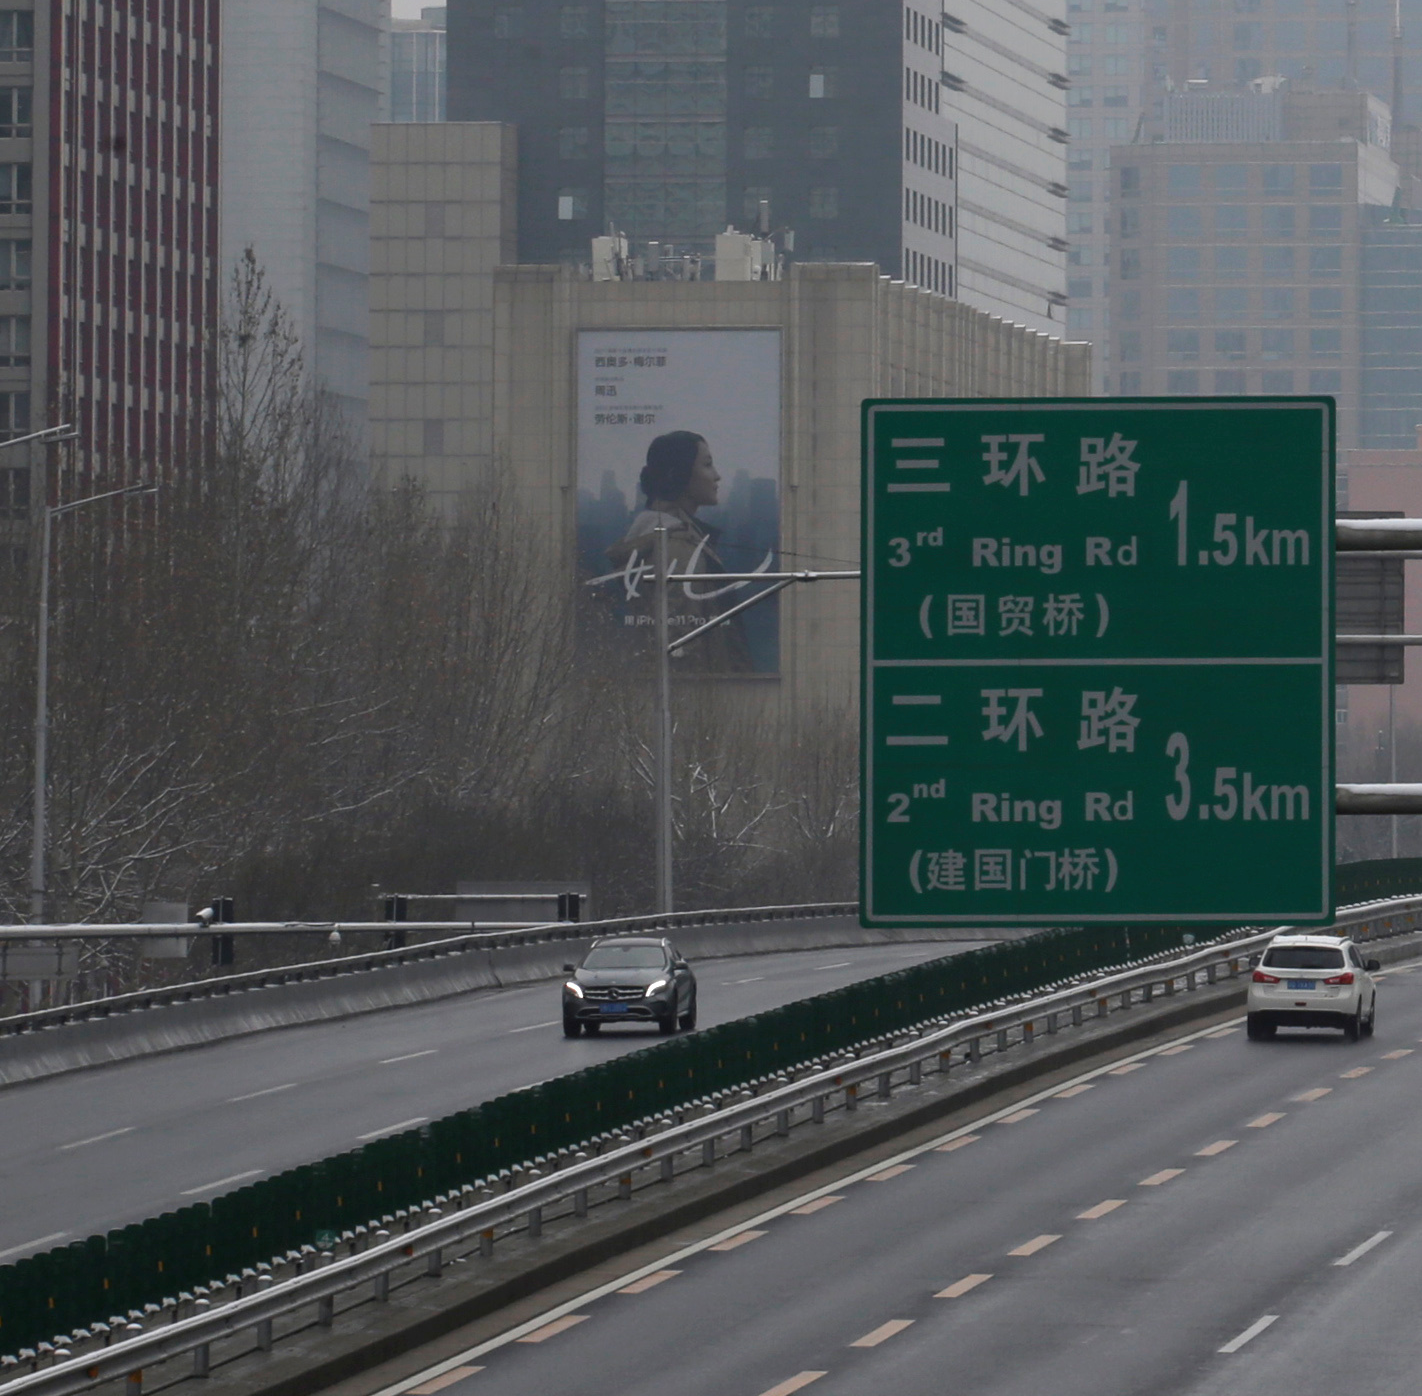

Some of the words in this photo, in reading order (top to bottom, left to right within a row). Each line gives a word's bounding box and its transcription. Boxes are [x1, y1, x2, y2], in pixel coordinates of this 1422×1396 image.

[887, 432, 1141, 497] 三环路
[888, 527, 944, 567] 3rd
[972, 537, 1063, 574] Ring
[1085, 536, 1138, 566] Rd
[1169, 480, 1310, 566] 1.5km
[919, 594, 1110, 638] (国贸桥)
[886, 686, 1141, 752] 二环路
[887, 779, 946, 823] 2nd
[971, 792, 1062, 830] Ring
[1084, 791, 1134, 822] Rd
[1165, 732, 1310, 821] 3.5km
[909, 847, 1118, 893] (建国门桥)
